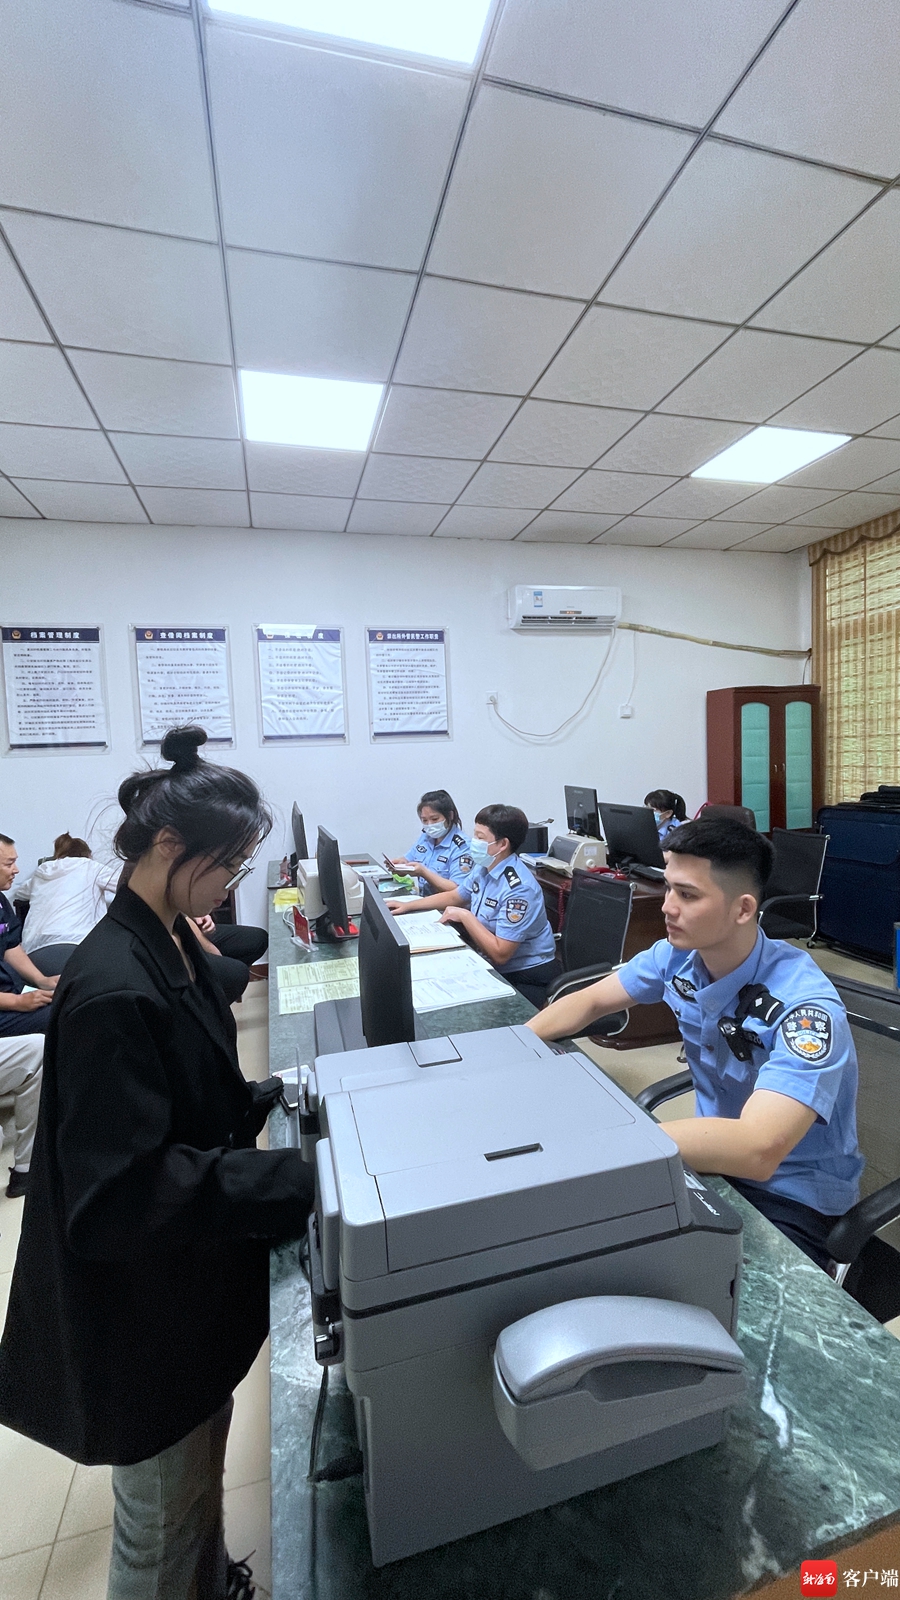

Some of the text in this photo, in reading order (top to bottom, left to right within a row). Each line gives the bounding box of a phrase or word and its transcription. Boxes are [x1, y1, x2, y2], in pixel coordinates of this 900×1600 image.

[30, 631, 80, 639] 档案管理制度
